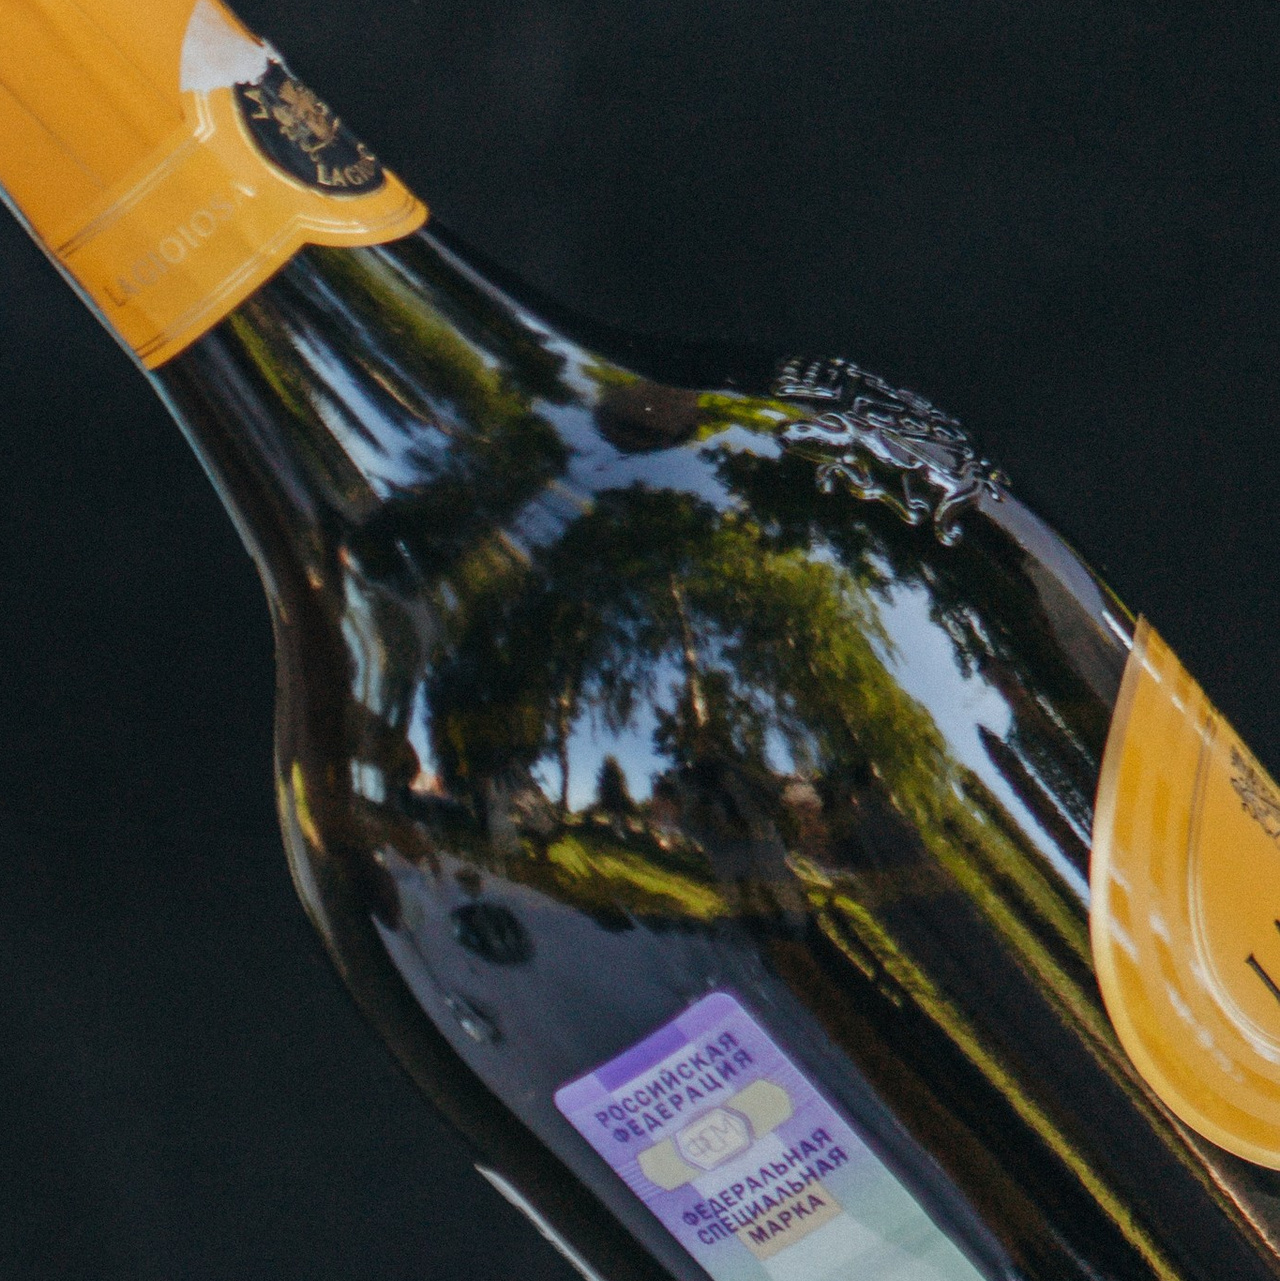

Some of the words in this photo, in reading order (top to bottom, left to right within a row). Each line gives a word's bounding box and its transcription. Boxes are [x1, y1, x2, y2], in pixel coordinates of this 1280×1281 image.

[594, 1031, 739, 1129] РОССИЙСКАЯ
[612, 1048, 754, 1143] ФЕДЕРАЦИЯ
[682, 1127, 834, 1226] ФЕДЕРАЛЬНАЯ
[697, 1146, 849, 1245] СПЕЦИАЛЬНАЯ
[748, 1194, 827, 1245] МАРКА
